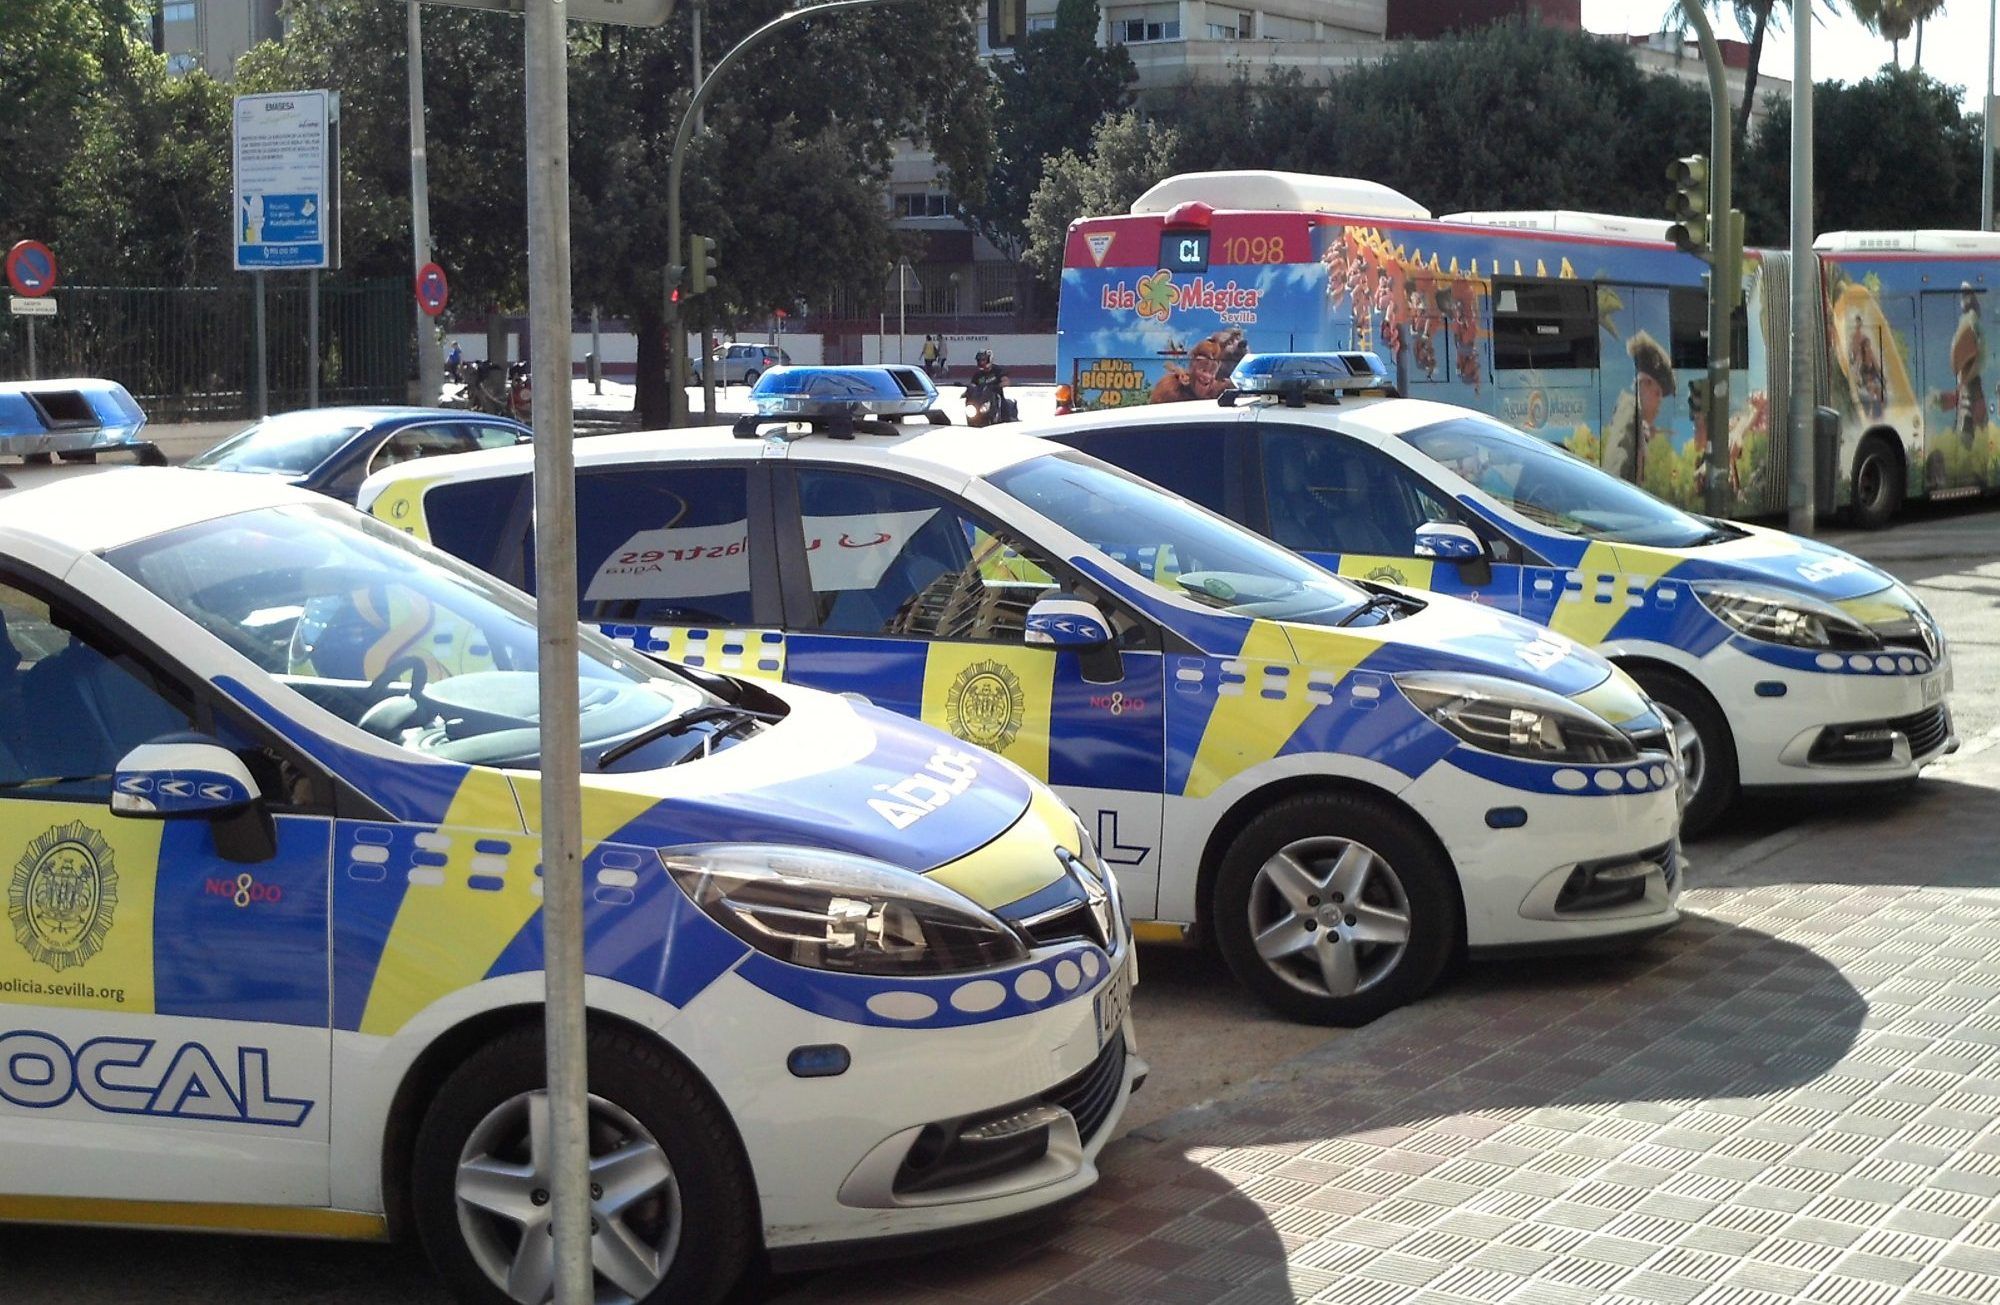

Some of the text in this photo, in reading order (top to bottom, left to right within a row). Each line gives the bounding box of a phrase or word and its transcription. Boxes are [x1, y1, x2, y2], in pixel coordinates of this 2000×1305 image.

[1179, 240, 1200, 262] C1
[1223, 235, 1284, 264] 1098
[1102, 275, 1258, 314] Isla Mágica
[1220, 311, 1257, 324] Sevilla
[1081, 370, 1144, 390] BIGFOOT
[1099, 390, 1122, 406] 4D
